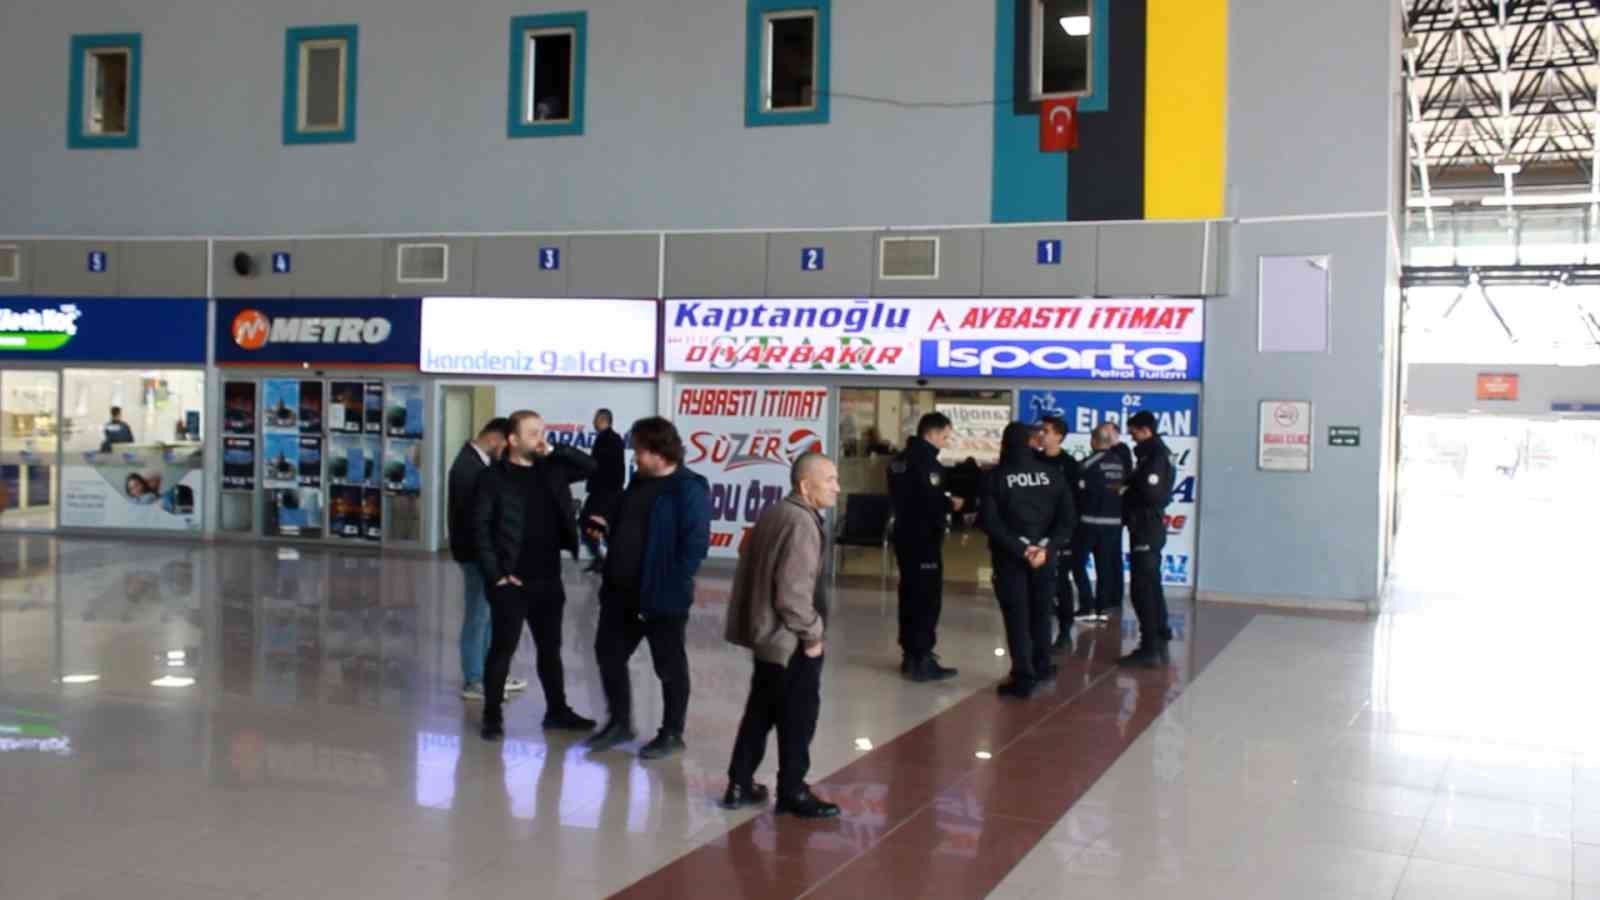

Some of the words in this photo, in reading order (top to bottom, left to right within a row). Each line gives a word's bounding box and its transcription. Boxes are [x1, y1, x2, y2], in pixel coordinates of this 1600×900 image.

[277, 254, 286, 271] 4
[544, 249, 554, 268] 3
[808, 249, 818, 269] 2
[1045, 242, 1054, 262] 1
[674, 300, 910, 333] Kaptanoğlu
[960, 307, 1082, 329] AYBASTI
[269, 317, 391, 344] METRO
[937, 340, 1187, 375] Isparta
[1091, 369, 1135, 379] Petrol
[678, 388, 758, 416] AYBASTI
